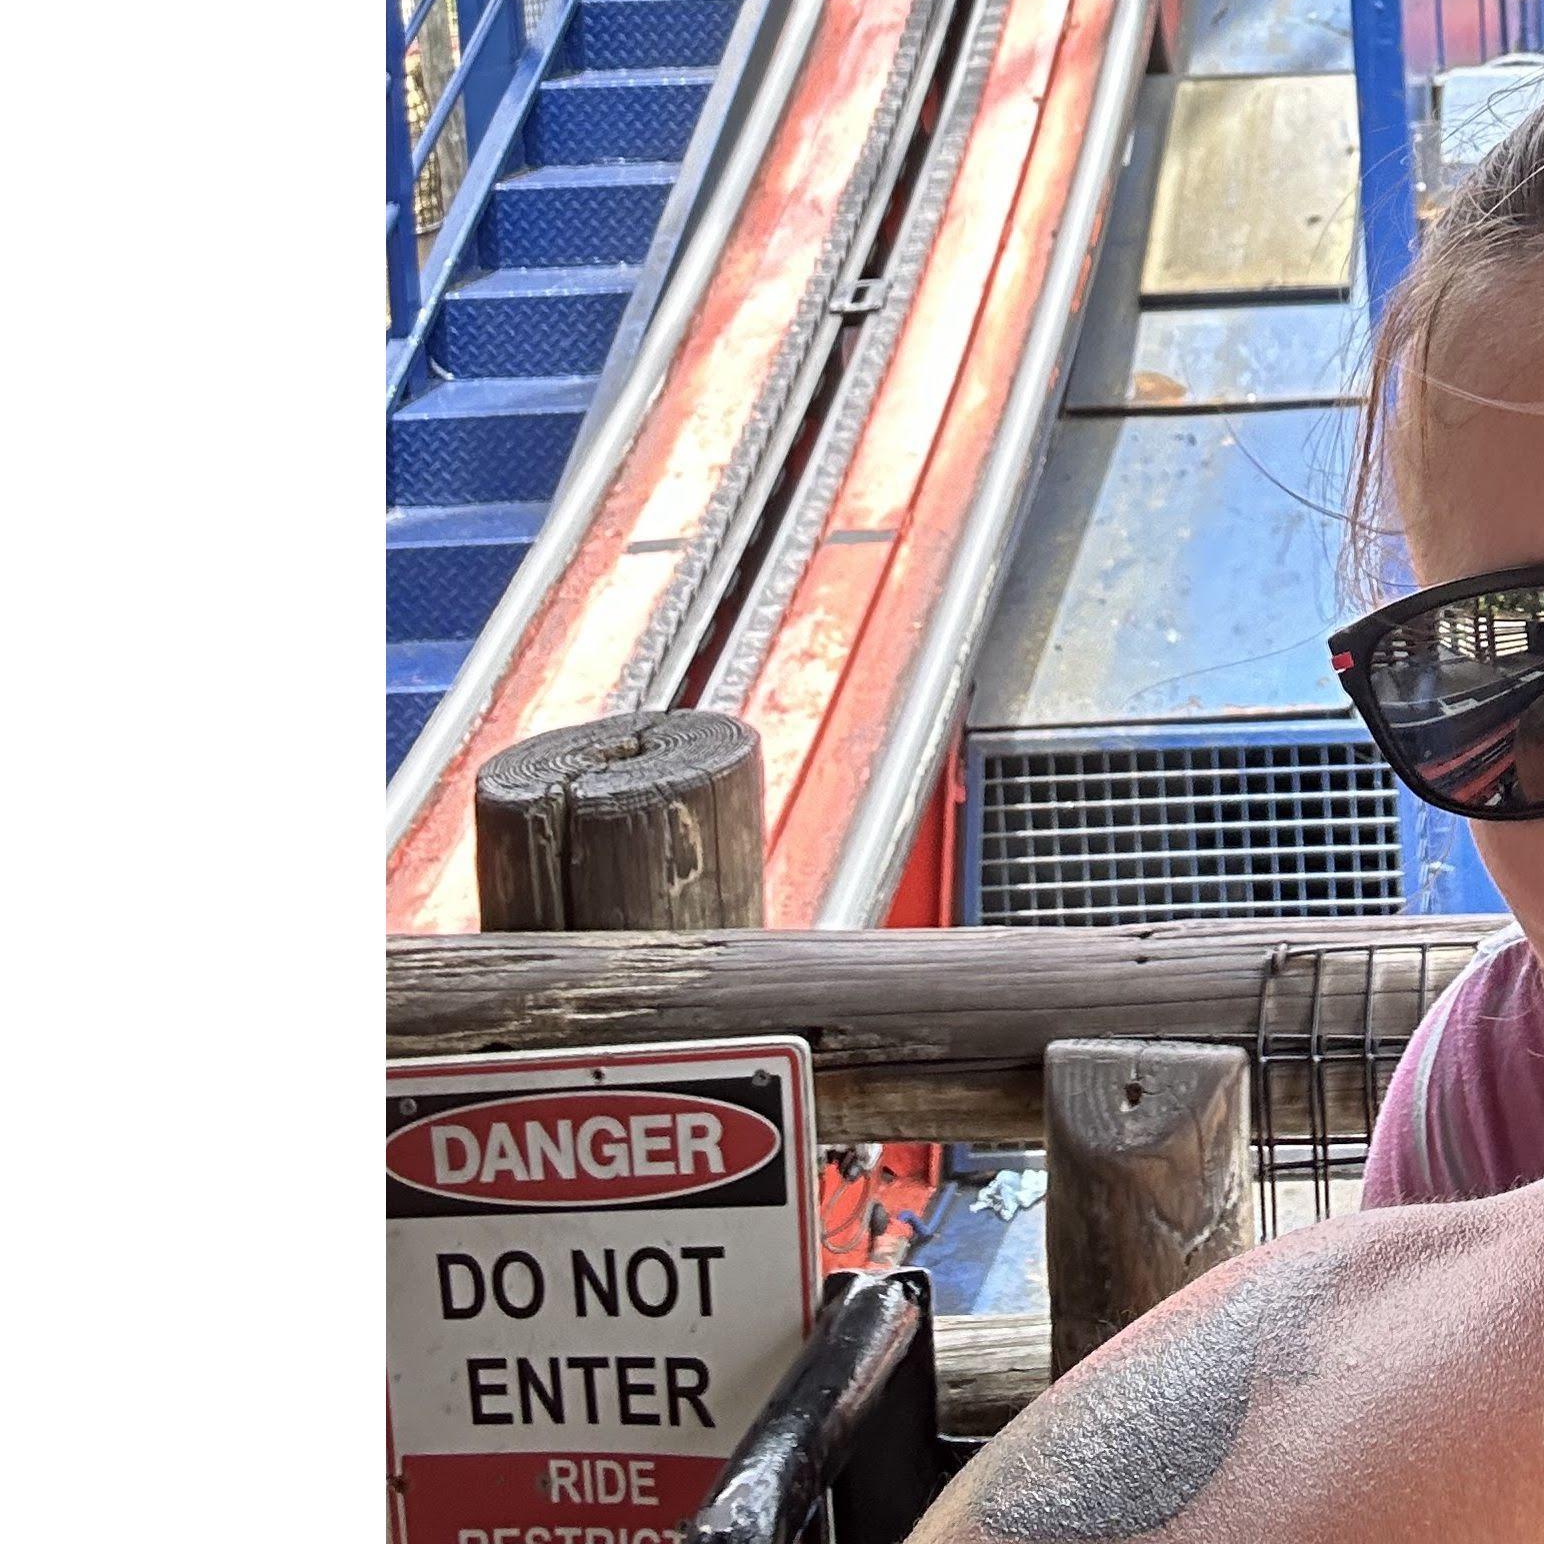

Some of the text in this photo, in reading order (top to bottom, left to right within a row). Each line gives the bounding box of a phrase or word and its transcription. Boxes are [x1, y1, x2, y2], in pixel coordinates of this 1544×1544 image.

[429, 1112, 727, 1186] DANGER
[436, 1246, 726, 1320] DO NOT
[466, 1356, 717, 1429] ENTER
[548, 1459, 660, 1506] RIDE
